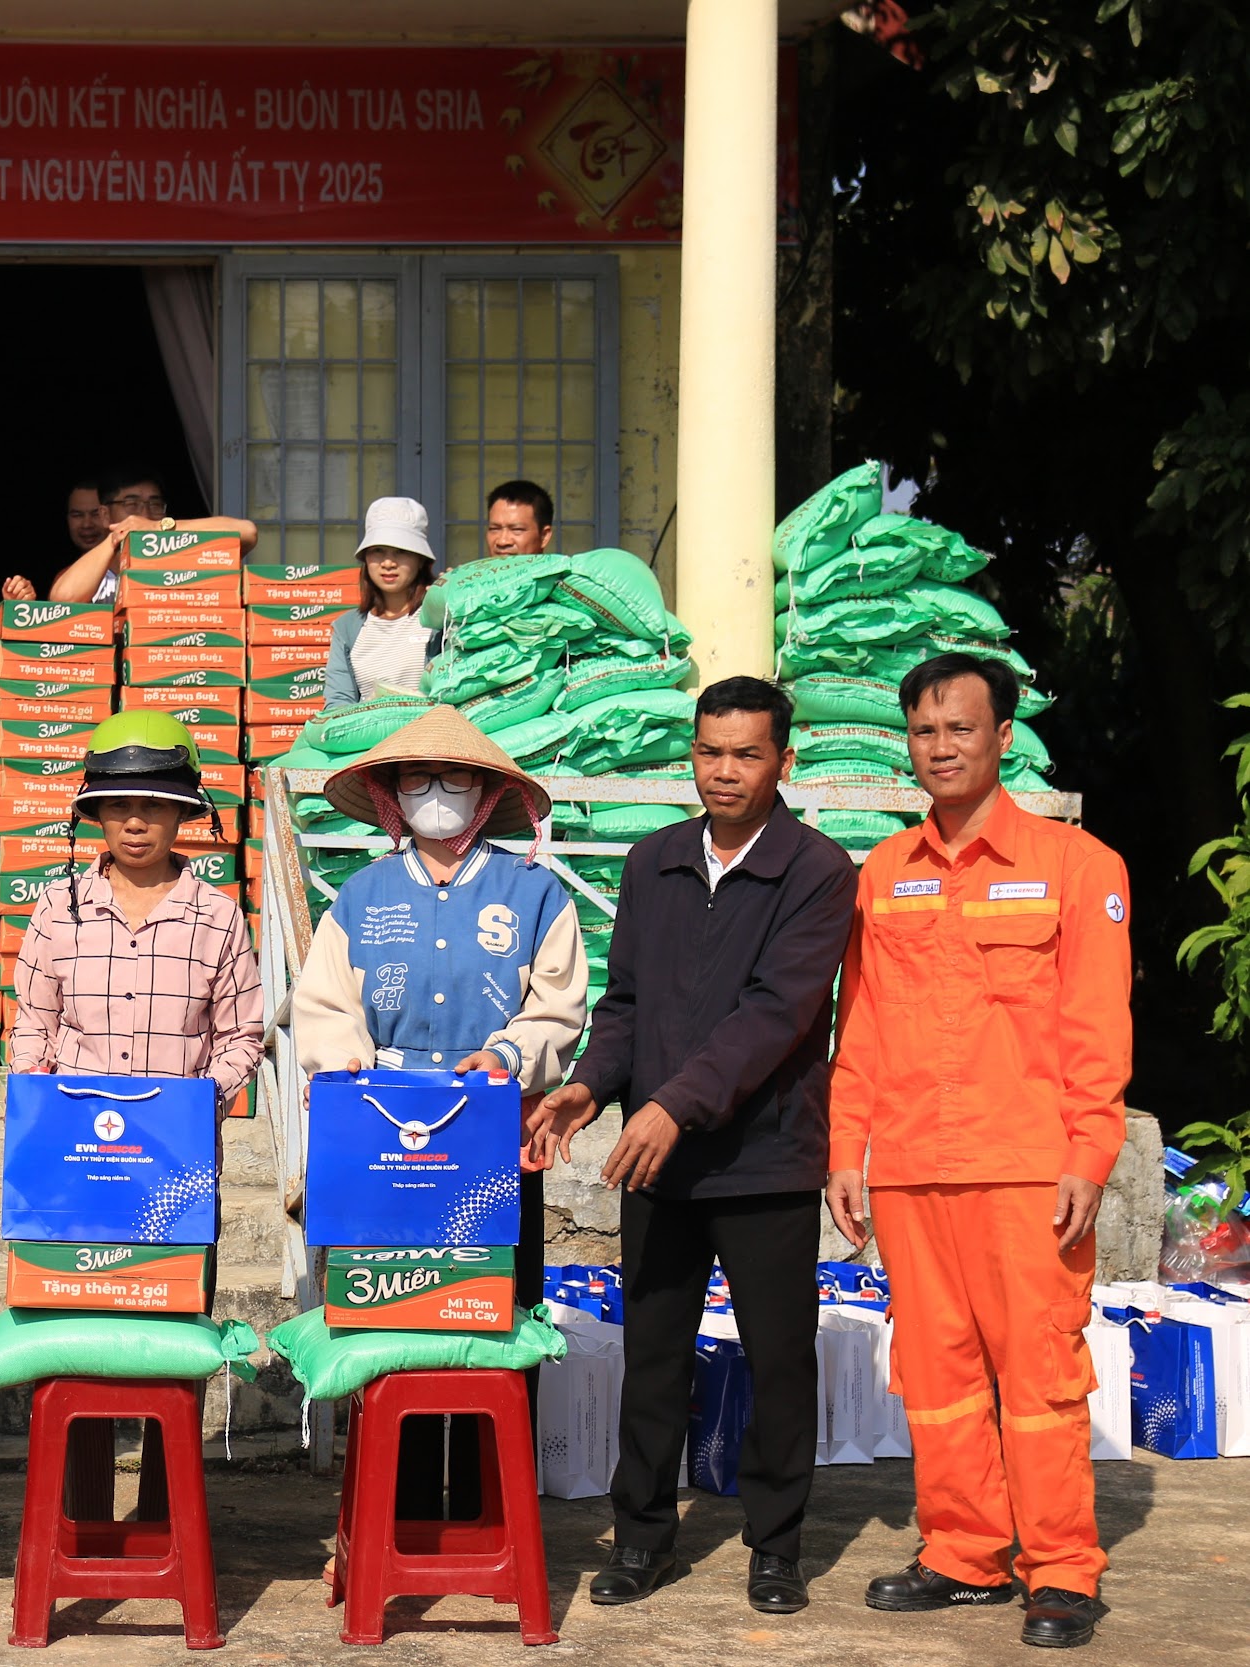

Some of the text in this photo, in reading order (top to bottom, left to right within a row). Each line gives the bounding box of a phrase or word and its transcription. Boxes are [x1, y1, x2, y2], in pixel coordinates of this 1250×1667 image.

[69, 73, 125, 128] KẾT
[134, 80, 228, 130] NGHĨA
[255, 80, 338, 131] BUÔN
[346, 89, 407, 131] TUA
[415, 89, 484, 131] SRIA
[22, 150, 145, 202] NGUYÊN
[154, 150, 222, 202] ĐÁN
[229, 146, 266, 202] ẤT
[273, 161, 309, 212] TỴ
[319, 162, 383, 203] 2025
[218, 558, 233, 566] Cay
[143, 592, 167, 602] Tặng
[170, 592, 195, 600] thêm
[204, 592, 219, 601] gói
[477, 903, 519, 957] S
[42, 1280, 168, 1300] Tặng thêm 2 gói
[447, 1298, 493, 1309] Mì Tôm
[439, 1309, 499, 1322] Chua Cay
